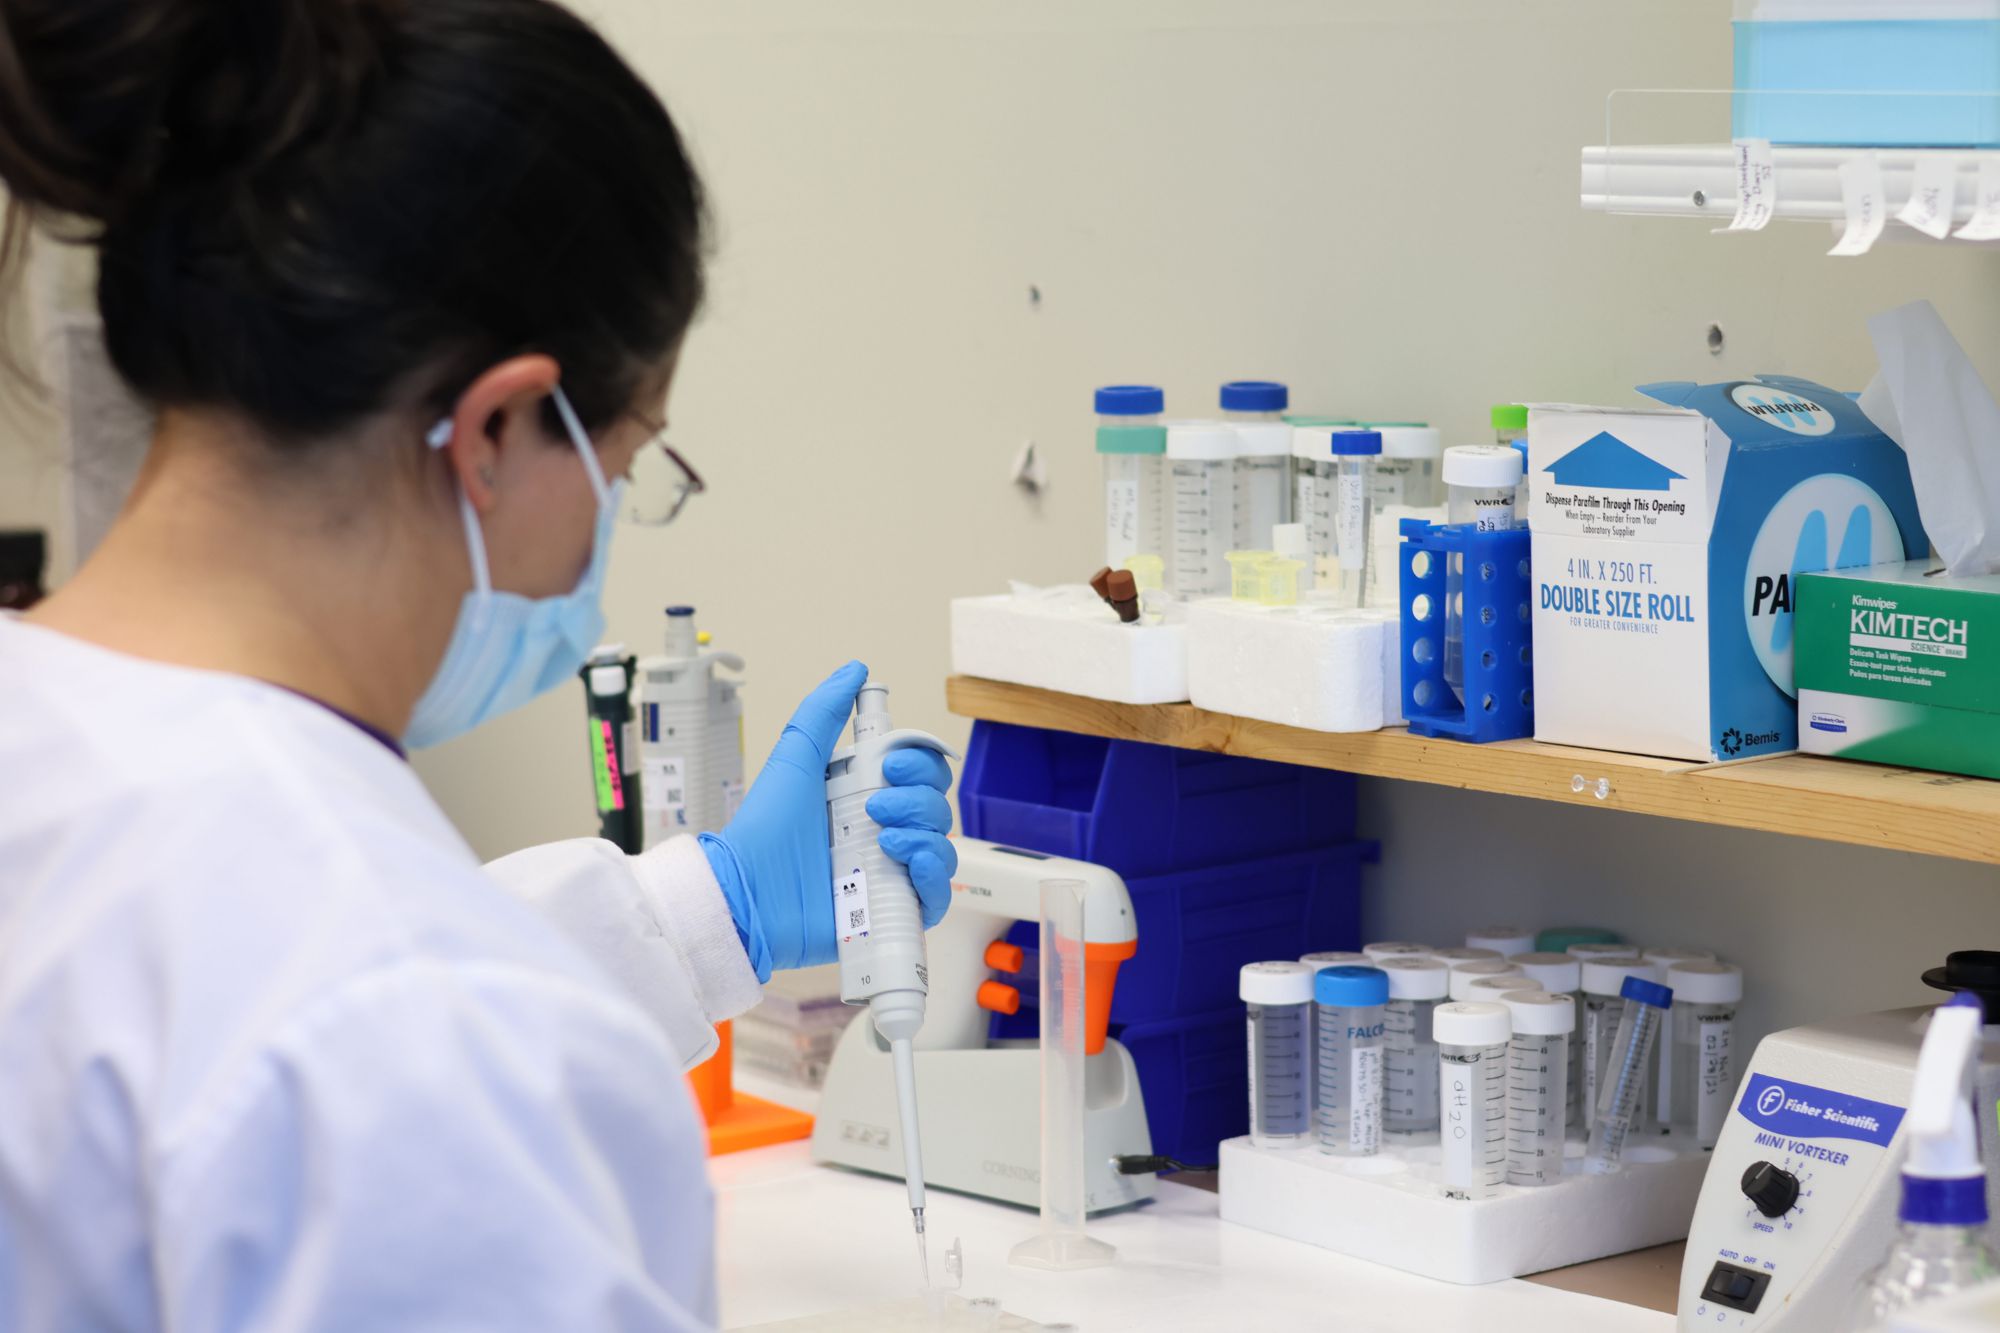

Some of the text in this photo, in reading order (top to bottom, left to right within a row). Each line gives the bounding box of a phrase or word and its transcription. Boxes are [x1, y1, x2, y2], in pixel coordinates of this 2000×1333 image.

[1748, 403, 1822, 415] PARAFILM
[1545, 492, 1685, 515] Dispense Parafilm Through This Opening
[1565, 510, 1579, 520] When
[1580, 511, 1595, 523] Empty
[1602, 513, 1624, 524] Reorder
[1626, 514, 1641, 525] From
[1643, 515, 1657, 525] Your
[1582, 524, 1635, 538] Laboratory Supplier
[1567, 558, 1657, 585] 4 IN. X 250 FT.
[1541, 583, 1695, 622] DOUBLE SIZE ROLL
[1752, 574, 1797, 616] PA
[1852, 594, 1897, 610] Kimwipes
[1570, 616, 1658, 634] FOR GREATER CONVENIENCE
[1850, 608, 1968, 644] KIMTECH
[1849, 648, 1912, 663] Delicate Task Wipers
[1883, 662, 1897, 672] pour
[1868, 672, 1882, 680] para
[1883, 673, 1902, 682] tareas
[1903, 676, 1932, 686] delicadas
[1745, 730, 1781, 746] Bemis
[970, 887, 992, 898] ULTRA
[861, 975, 871, 986] 10
[1784, 1098, 1822, 1118] Fisher
[1822, 1108, 1880, 1132] Scientific
[1754, 1132, 1849, 1166] MINI VORTEXER
[1752, 1222, 1774, 1233] SPEED
[1784, 1222, 1792, 1230] 10
[1719, 1248, 1776, 1270] AUTO OFF ON
